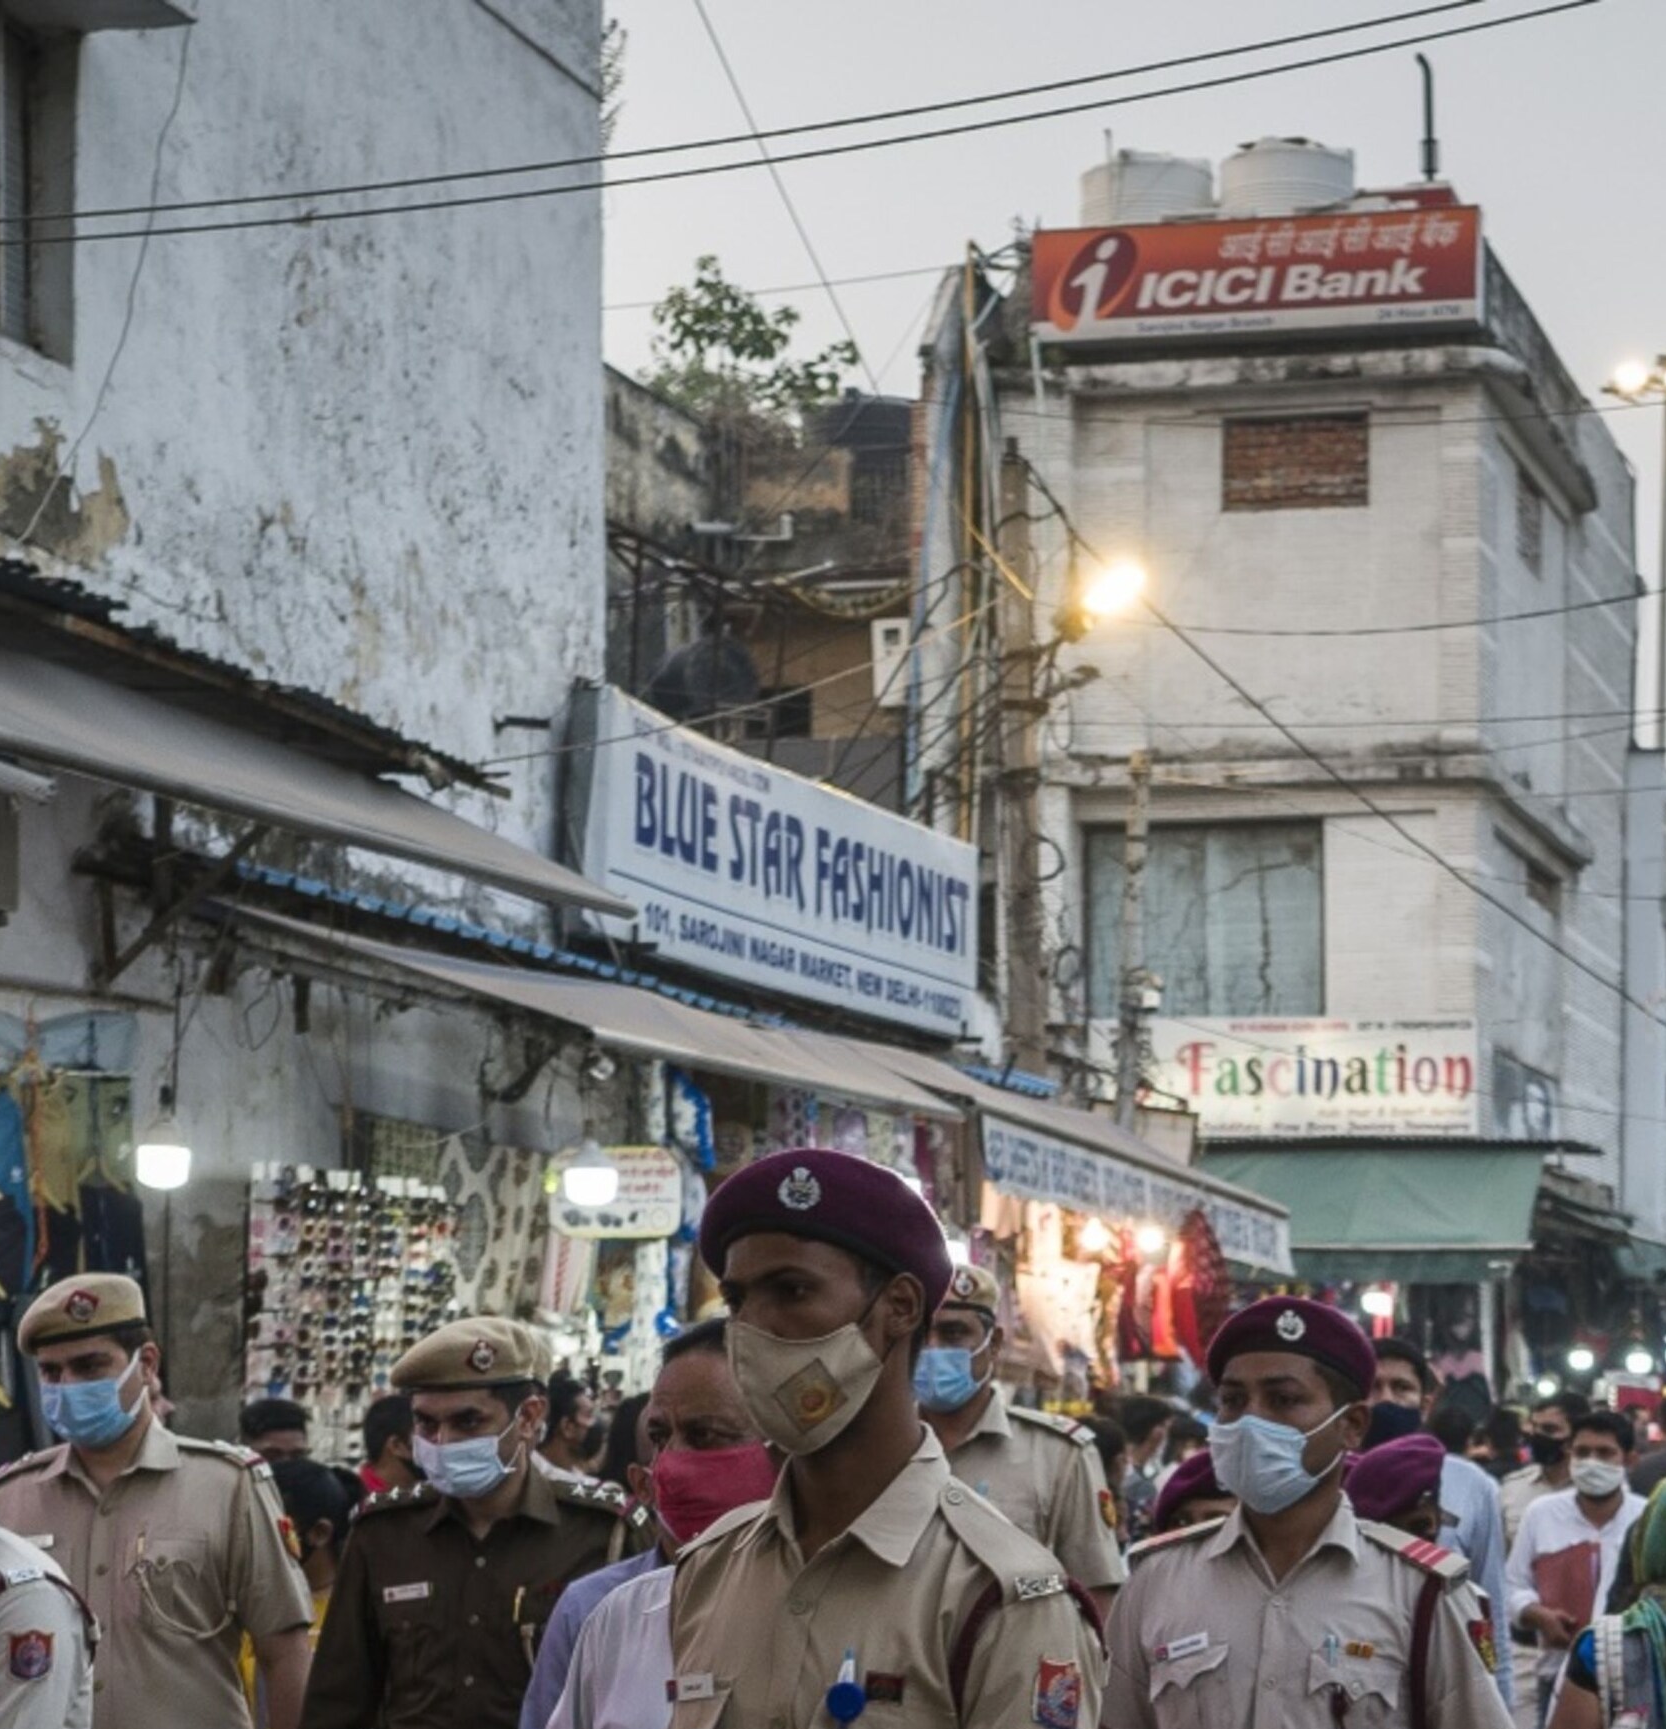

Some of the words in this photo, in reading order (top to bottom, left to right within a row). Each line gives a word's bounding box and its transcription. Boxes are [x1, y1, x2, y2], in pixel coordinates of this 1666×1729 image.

[1136, 266, 1276, 310] ICICI
[1280, 257, 1428, 303] Bank
[635, 751, 720, 874] BLUE
[729, 793, 807, 913] STAR
[814, 826, 970, 958] FASHIONIST
[679, 913, 747, 959] SAROJINI
[749, 937, 796, 974] NAGAR
[856, 969, 883, 998] NEW
[1175, 1041, 1474, 1100] Fascination
